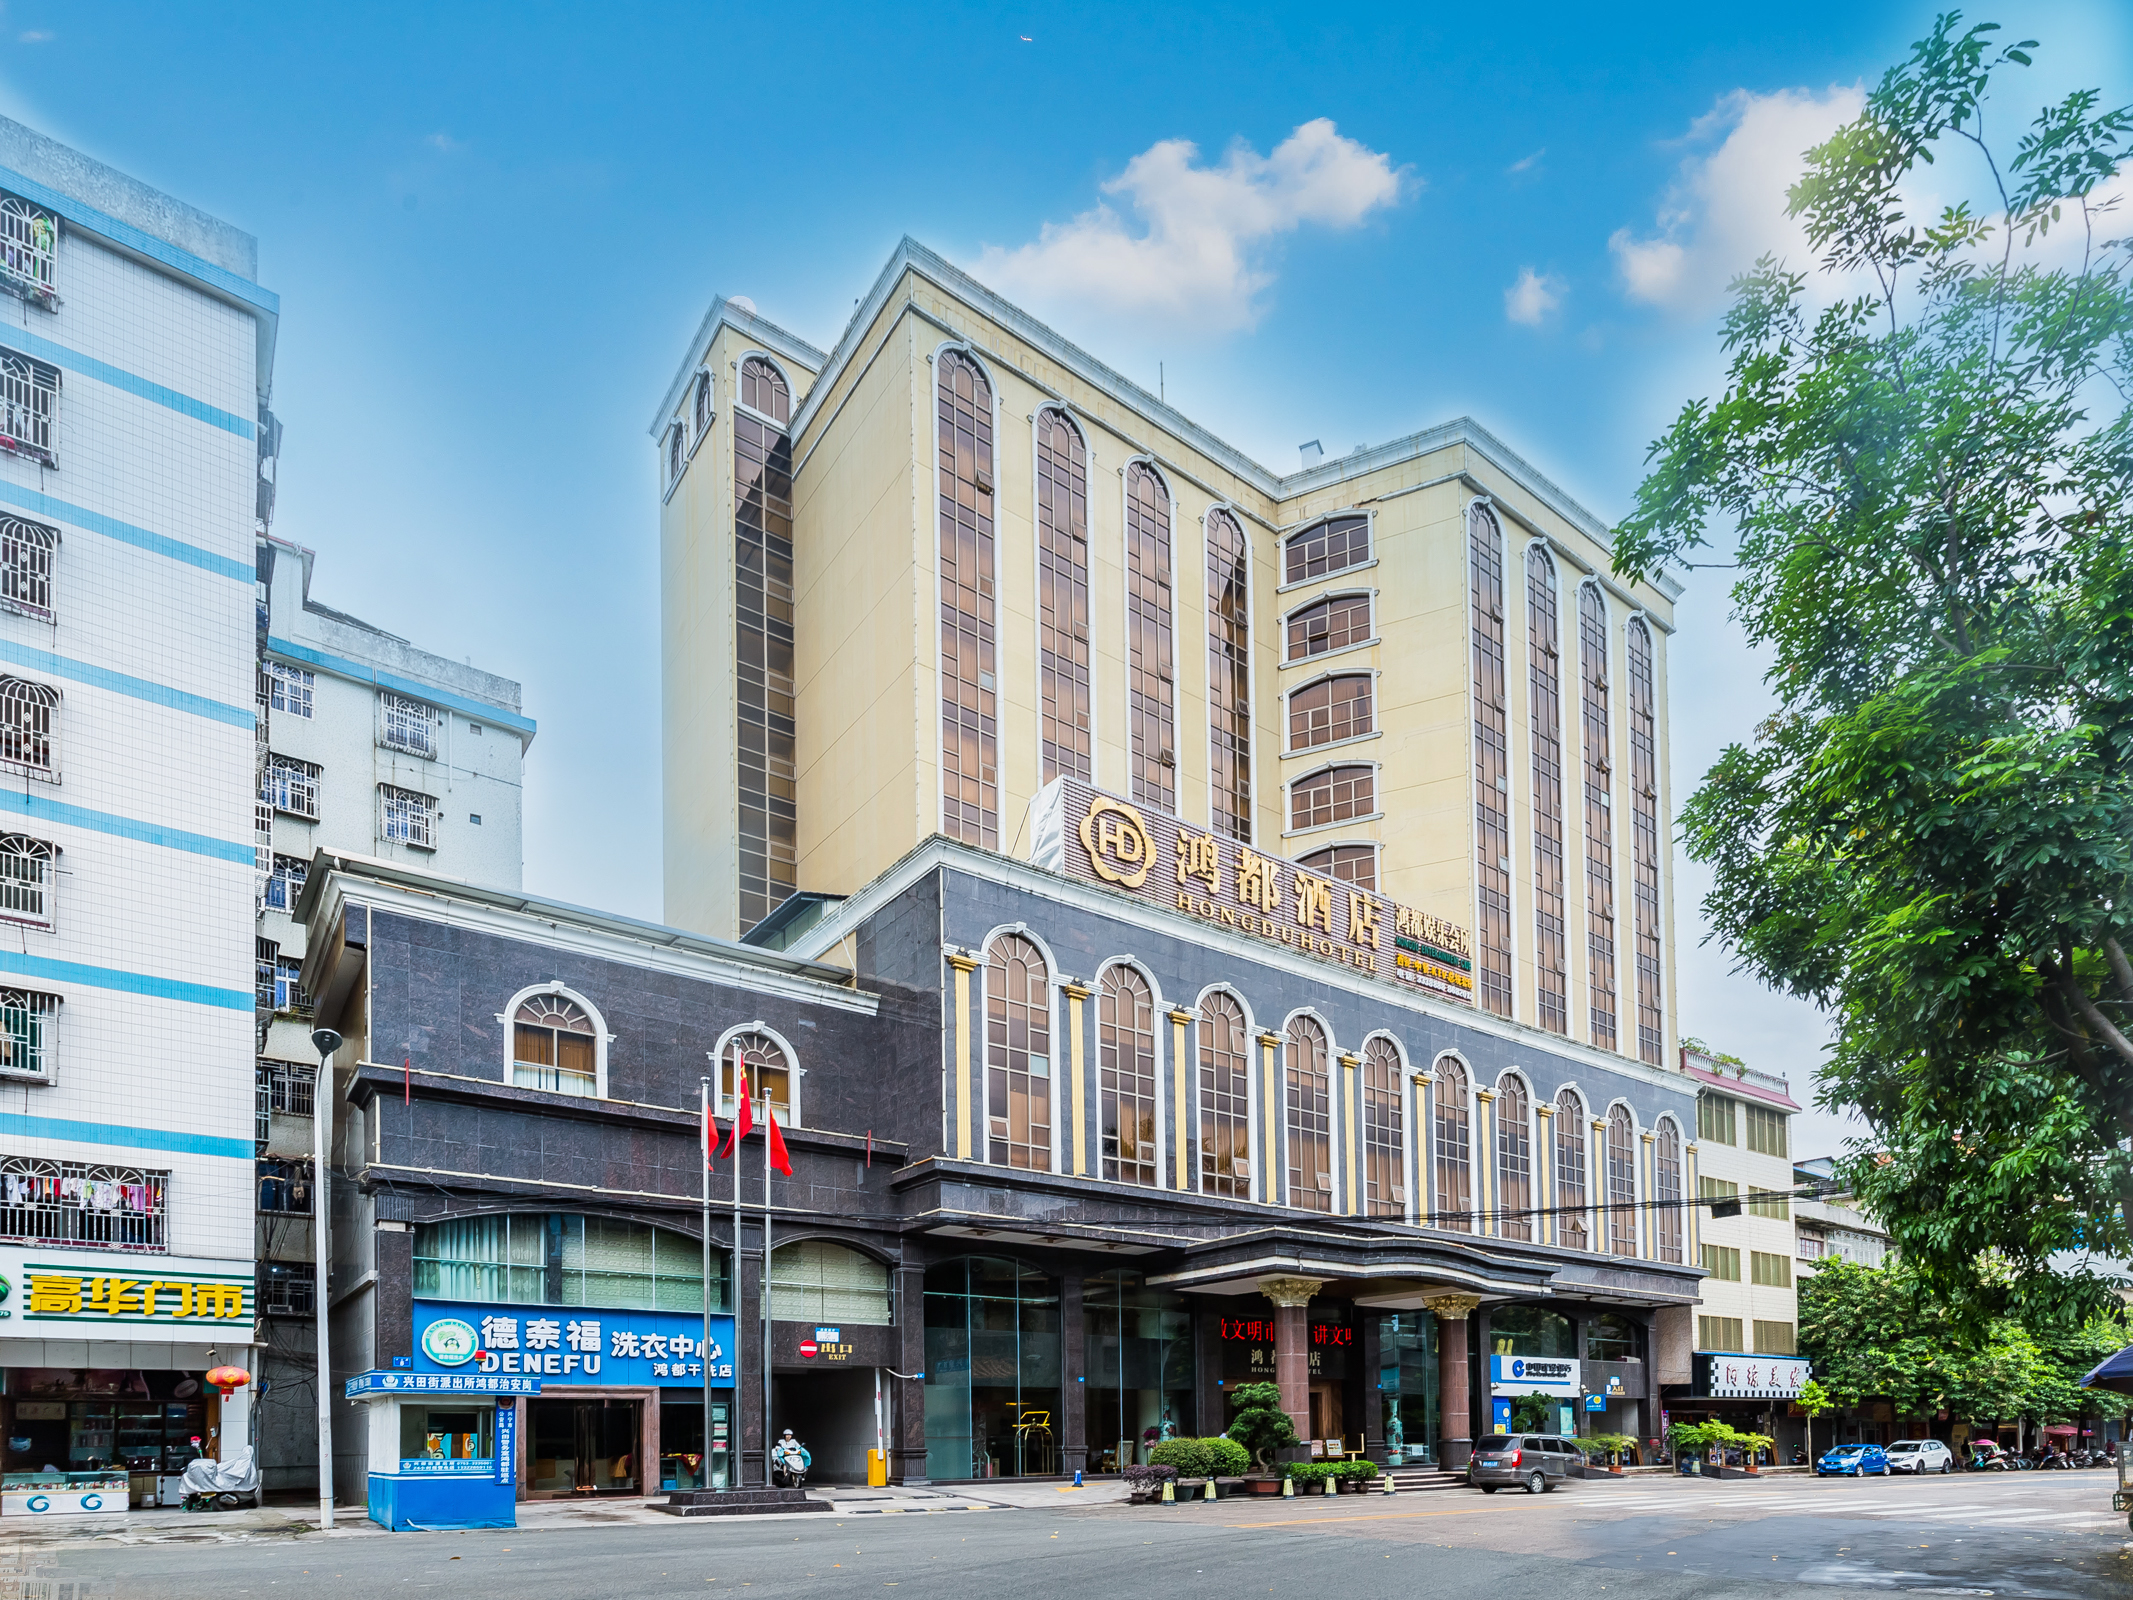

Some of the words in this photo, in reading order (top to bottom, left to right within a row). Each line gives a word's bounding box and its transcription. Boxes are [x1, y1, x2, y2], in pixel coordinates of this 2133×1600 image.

[1098, 817, 1143, 863] HD
[1175, 827, 1383, 950] 鸿都酒店
[30, 1275, 244, 1319] 高华门市
[481, 1315, 602, 1352] 德奈福
[611, 1330, 722, 1360] 洗衣中心
[820, 1342, 853, 1354] 出口
[481, 1352, 601, 1374] DENEFU
[828, 1353, 847, 1361] EXIT
[402, 1375, 532, 1391] 兴田街派出所鸿都治安岗
